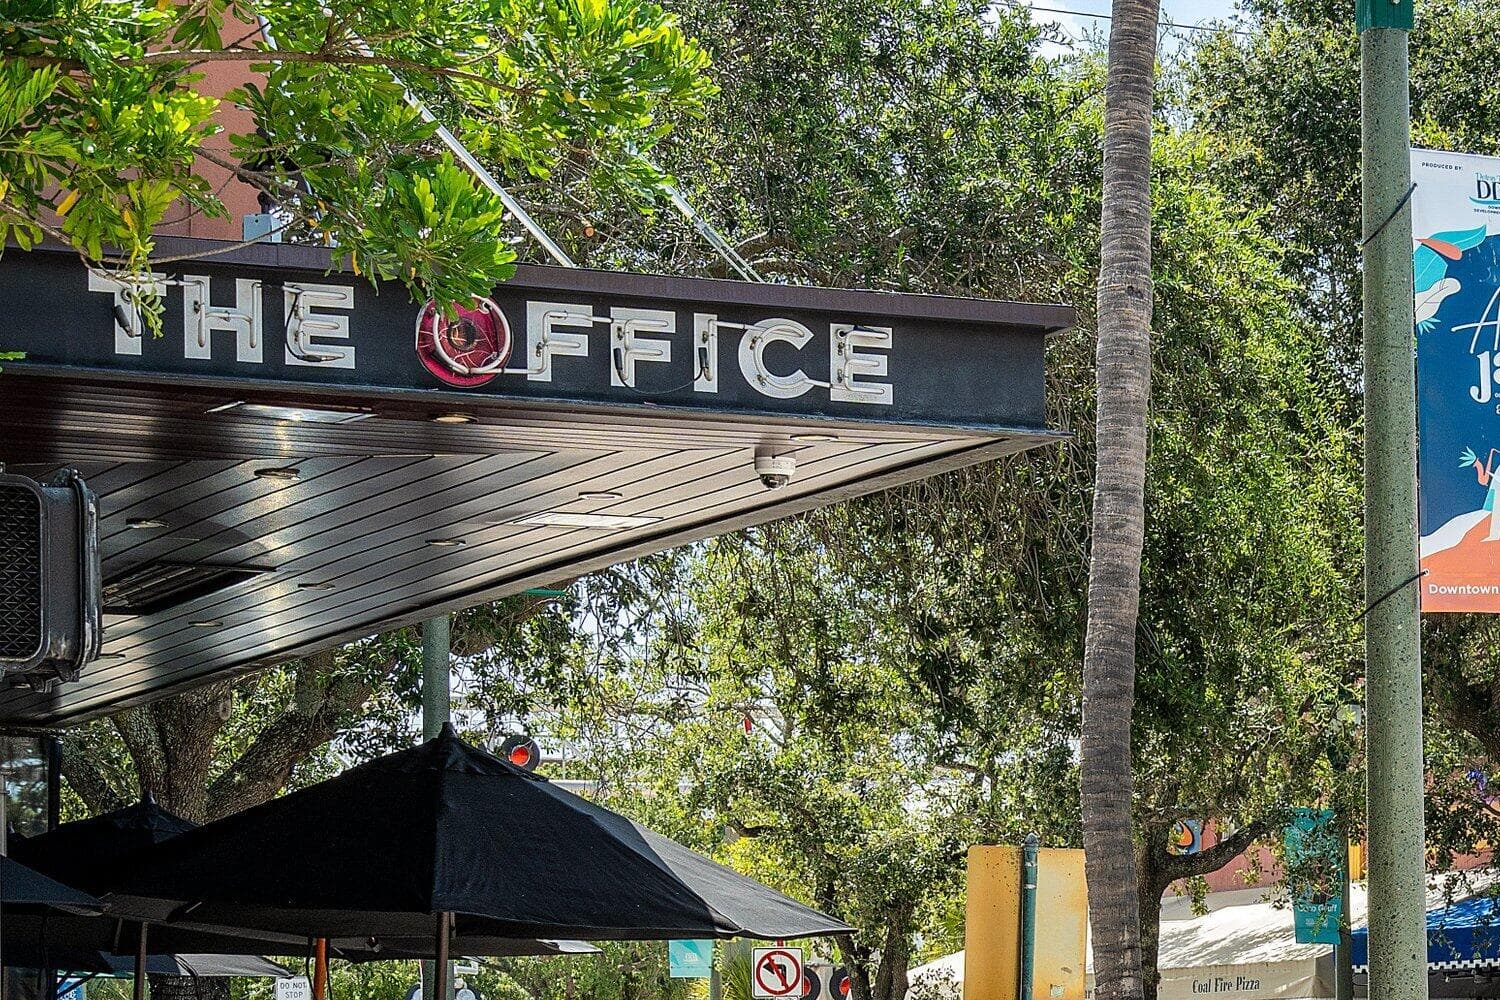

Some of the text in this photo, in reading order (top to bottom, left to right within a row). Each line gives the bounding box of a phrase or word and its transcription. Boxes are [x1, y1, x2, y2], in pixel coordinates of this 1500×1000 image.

[1421, 161, 1453, 170] PRODUCED
[88, 268, 894, 405] THE OFFICE
[280, 982, 307, 990] DO NOT
[1192, 976, 1260, 994] Coal Fire Pizza
[285, 991, 303, 999] STOP
